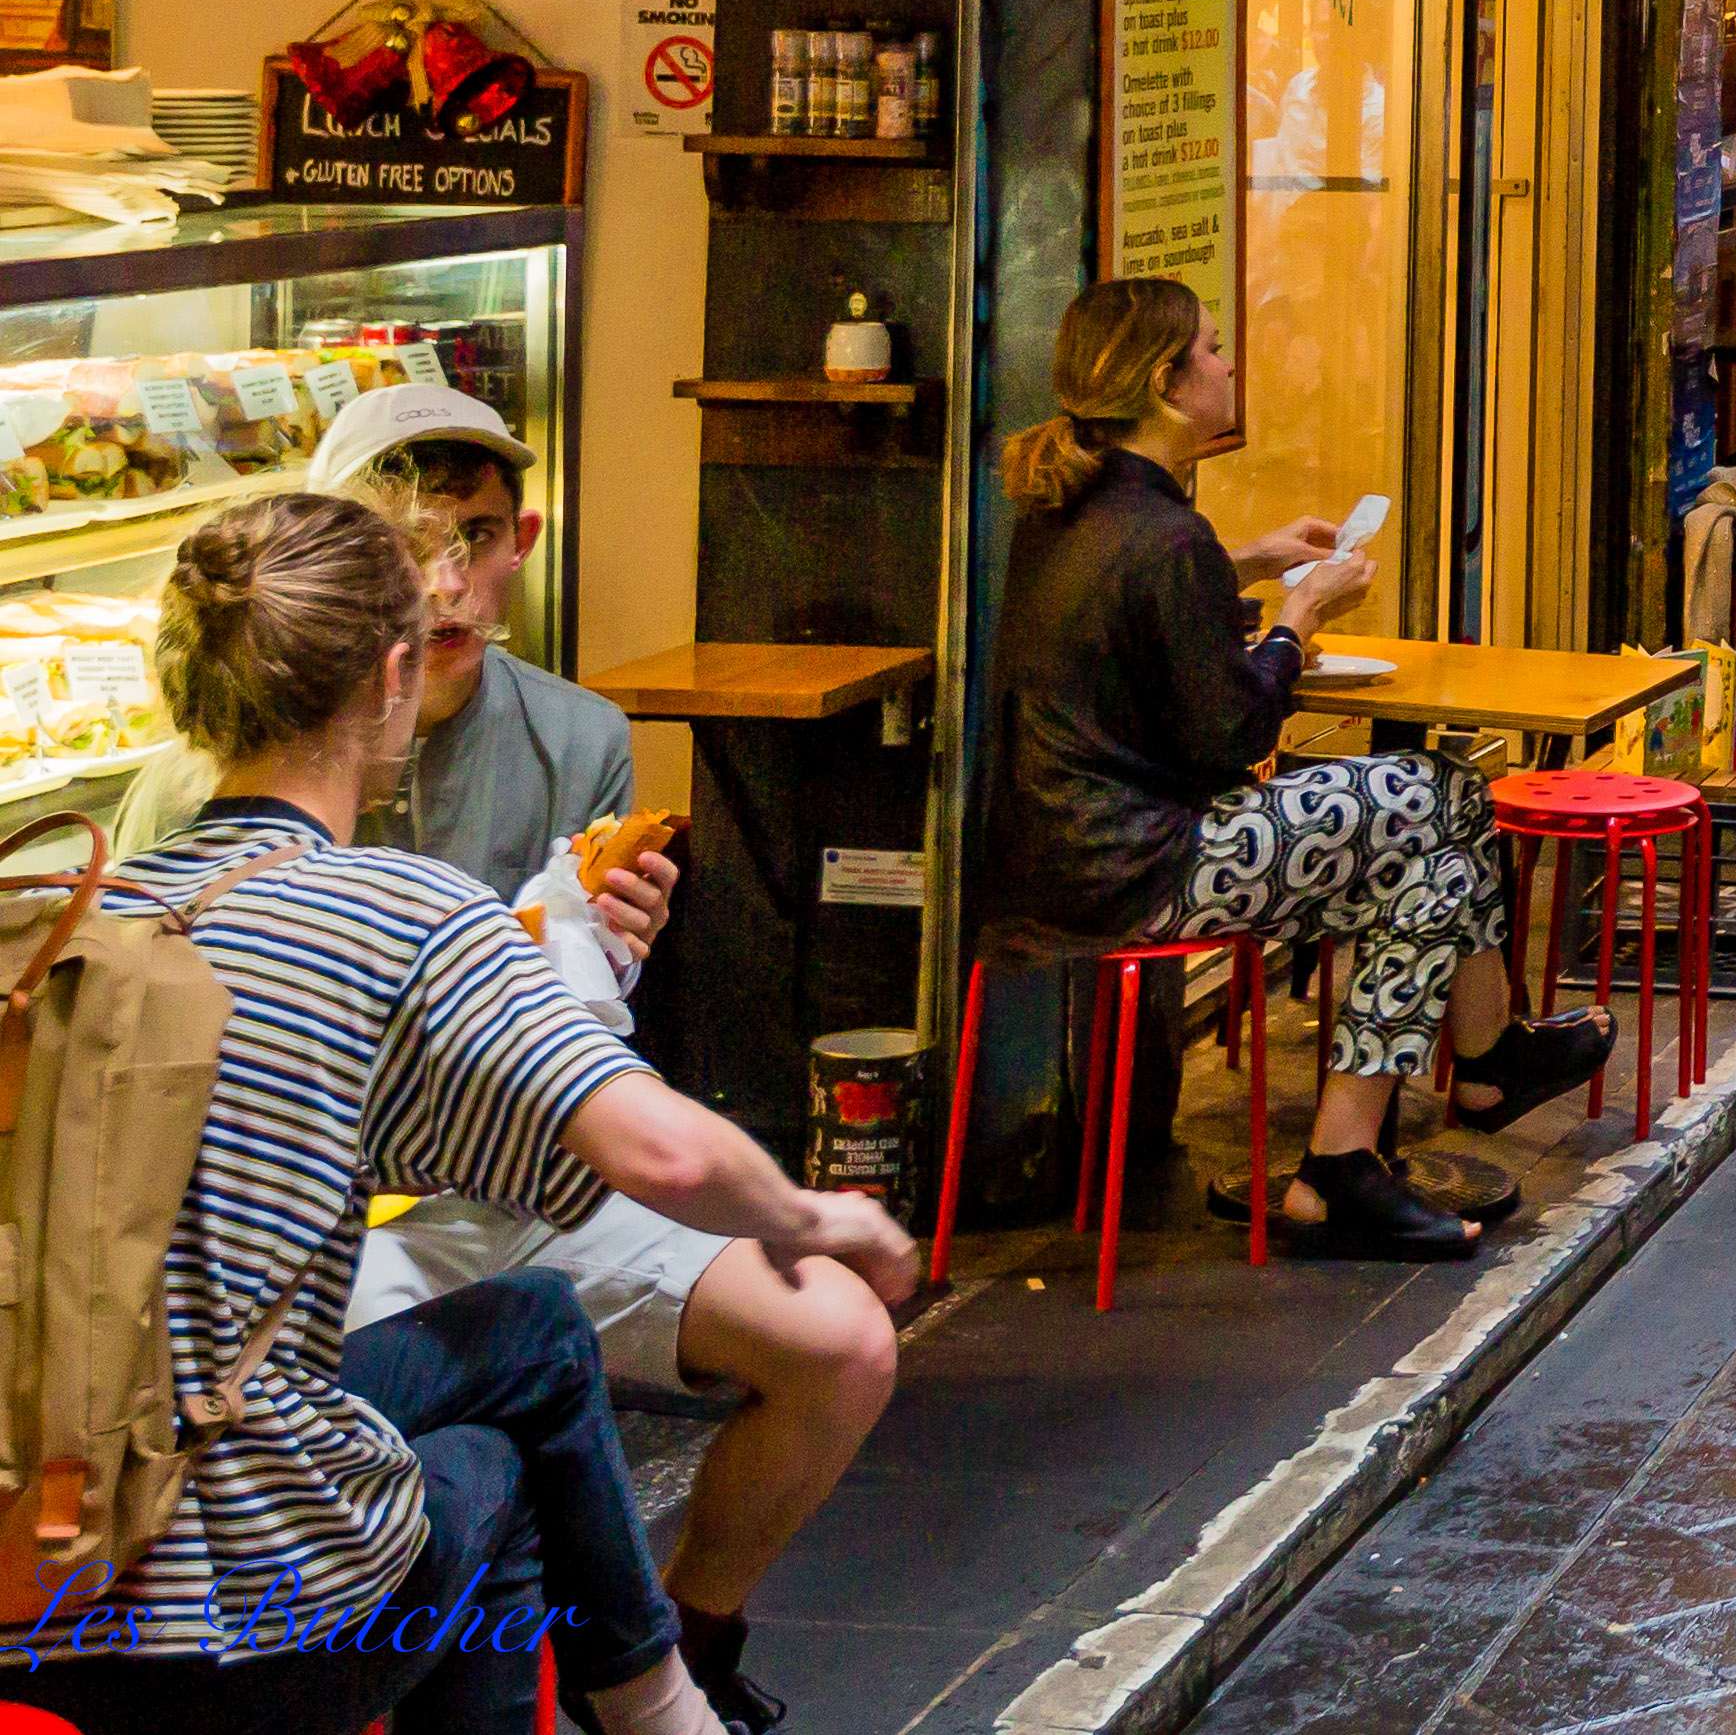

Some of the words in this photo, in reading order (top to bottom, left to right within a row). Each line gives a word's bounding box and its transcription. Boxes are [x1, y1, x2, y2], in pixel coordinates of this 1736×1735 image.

[638, 9, 714, 26] SMOKIN
[1123, 15, 1138, 32] on
[1139, 10, 1165, 30] toast
[1167, 7, 1189, 30] plus
[1132, 37, 1150, 57] hot
[1152, 33, 1179, 54] drink
[1180, 27, 1220, 52] $12.00
[1123, 72, 1170, 95] Omelette
[1172, 66, 1194, 89] with
[1138, 122, 1165, 144] toast
[1166, 118, 1188, 142] plus
[1131, 151, 1150, 171] hot
[1151, 146, 1179, 166] drink
[1180, 138, 1220, 163] $12.00
[302, 158, 370, 188] GLUTEN
[378, 163, 425, 193] FREE
[435, 166, 516, 197] OPTIONS
[1170, 224, 1188, 242] sea
[1190, 218, 1210, 238] salt
